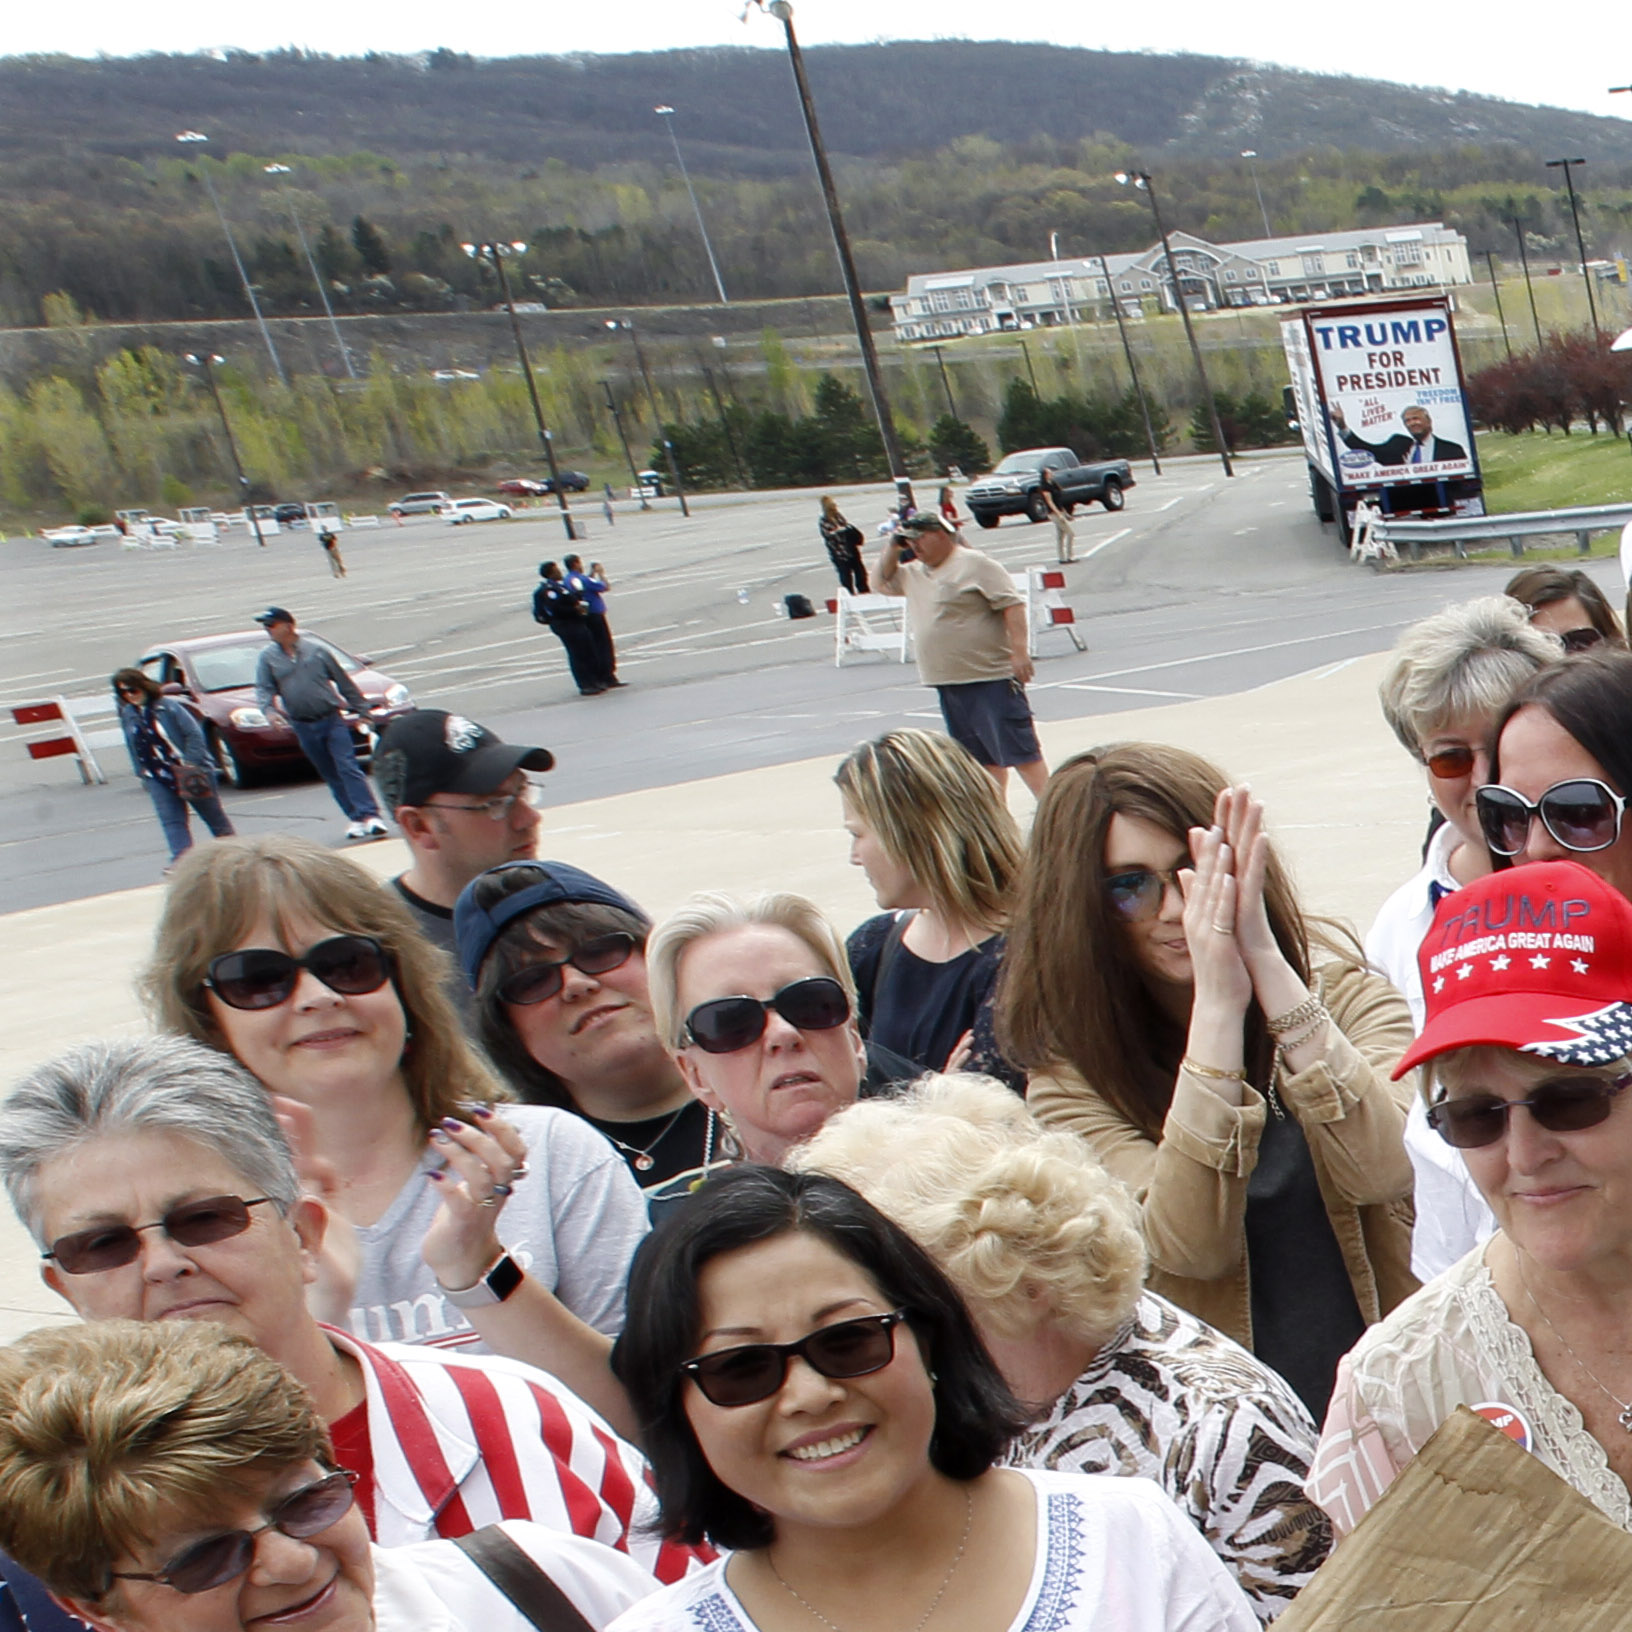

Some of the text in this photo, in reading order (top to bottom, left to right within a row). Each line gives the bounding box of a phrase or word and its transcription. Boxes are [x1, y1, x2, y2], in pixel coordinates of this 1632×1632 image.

[1315, 319, 1446, 350] TRUMP
[1367, 350, 1405, 369] FOR
[1336, 368, 1440, 392] PRESIDENT
[1361, 406, 1386, 418] LIVES
[1374, 468, 1410, 478] AMERICA
[1412, 465, 1440, 475] GREAT
[1443, 894, 1590, 945] TRUMP
[1430, 932, 1594, 973] MAKE AMERICA GREAT AGAIN
